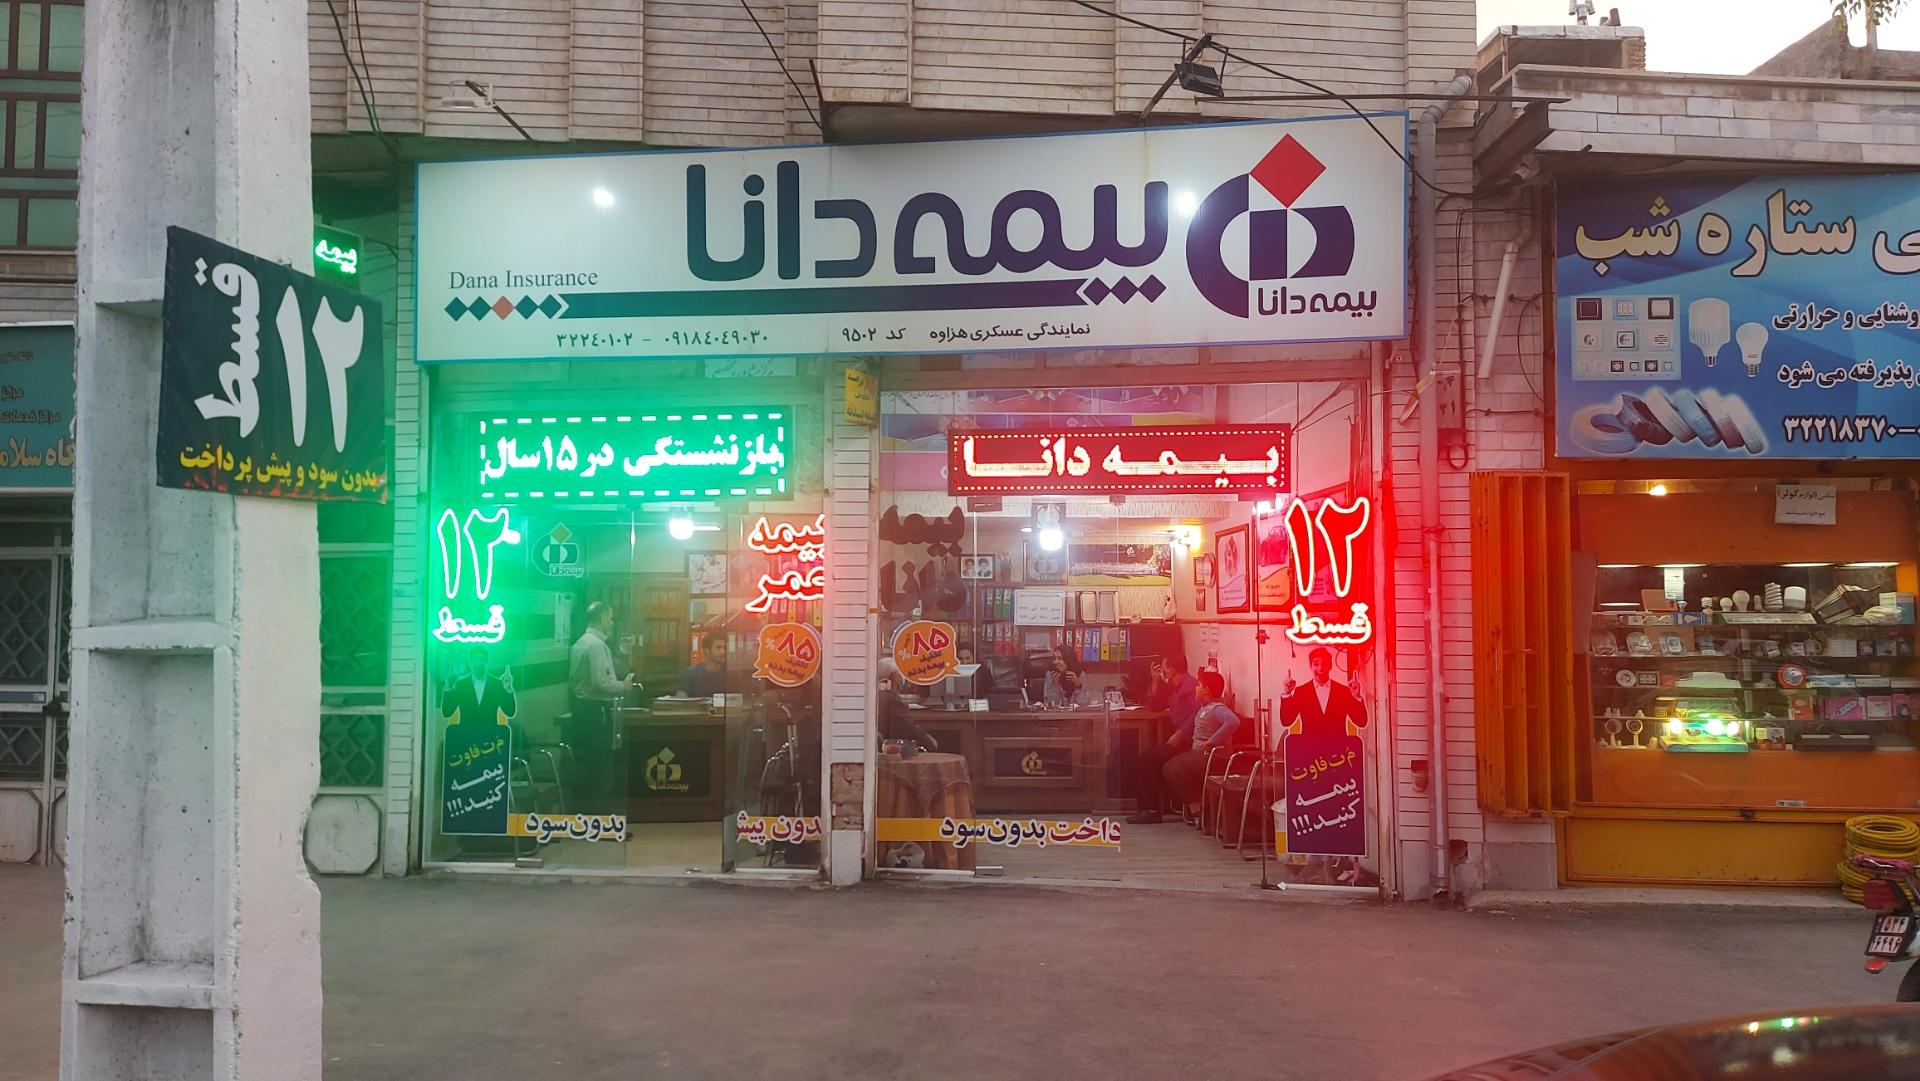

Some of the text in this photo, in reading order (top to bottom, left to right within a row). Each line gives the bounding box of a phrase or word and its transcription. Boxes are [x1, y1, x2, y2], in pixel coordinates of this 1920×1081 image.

[686, 160, 1169, 306] بیمه دانا
[1575, 195, 1681, 277] شب
[1696, 188, 1857, 278] ستاره
[315, 239, 357, 274] بیمه
[449, 270, 598, 289] Dana Insurance
[1257, 286, 1378, 318] بیمه دانا
[1773, 302, 1920, 330] وشنایی و حرارتی
[194, 256, 261, 438] قسط
[842, 323, 1091, 343] نمایندگی عسکری هزاوه کد ۹۵۰۲
[275, 284, 365, 454] ۱۲
[1778, 362, 1814, 388] شود
[1817, 368, 1845, 387] می
[1850, 360, 1912, 388] پذیرفته
[179, 443, 378, 492] بدون سود و پیش پرداخت
[579, 442, 615, 478] در
[963, 436, 1279, 488] بیمه دانا
[437, 508, 509, 600] ۱۲
[1284, 497, 1370, 598] ۱۲
[432, 604, 506, 643] قسط
[1285, 602, 1372, 644] قسط
[451, 763, 505, 791] بیمه
[1295, 777, 1360, 807] بیمه
[526, 813, 625, 842] بدون سود
[771, 817, 821, 843] دون
[940, 818, 986, 848] سود
[989, 818, 1047, 847] بدون
